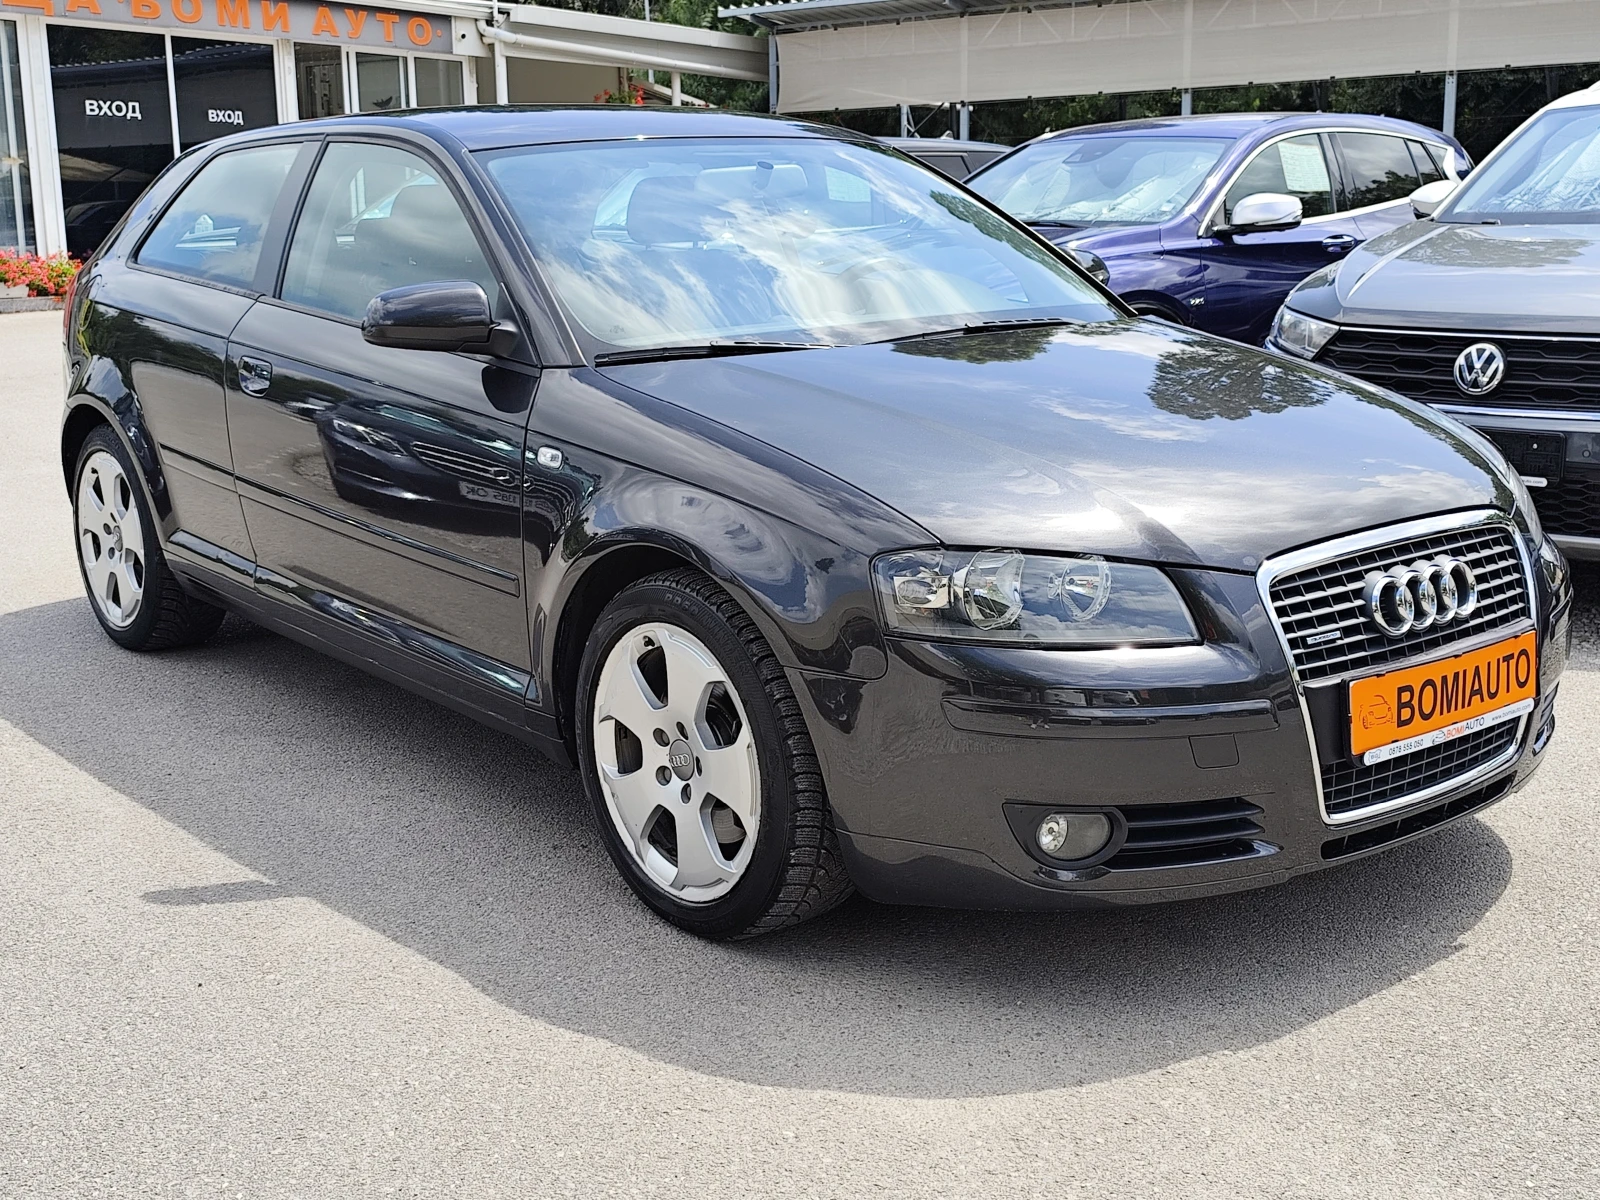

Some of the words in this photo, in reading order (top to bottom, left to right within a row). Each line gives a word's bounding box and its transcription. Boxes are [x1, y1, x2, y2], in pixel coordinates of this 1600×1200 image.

[311, 6, 433, 47] АУТО
[84, 99, 142, 120] ВХОД
[207, 109, 244, 126] ВХОД
[1396, 648, 1531, 729] BOMIAUTO
[1446, 716, 1485, 739] BOMIAUTO
